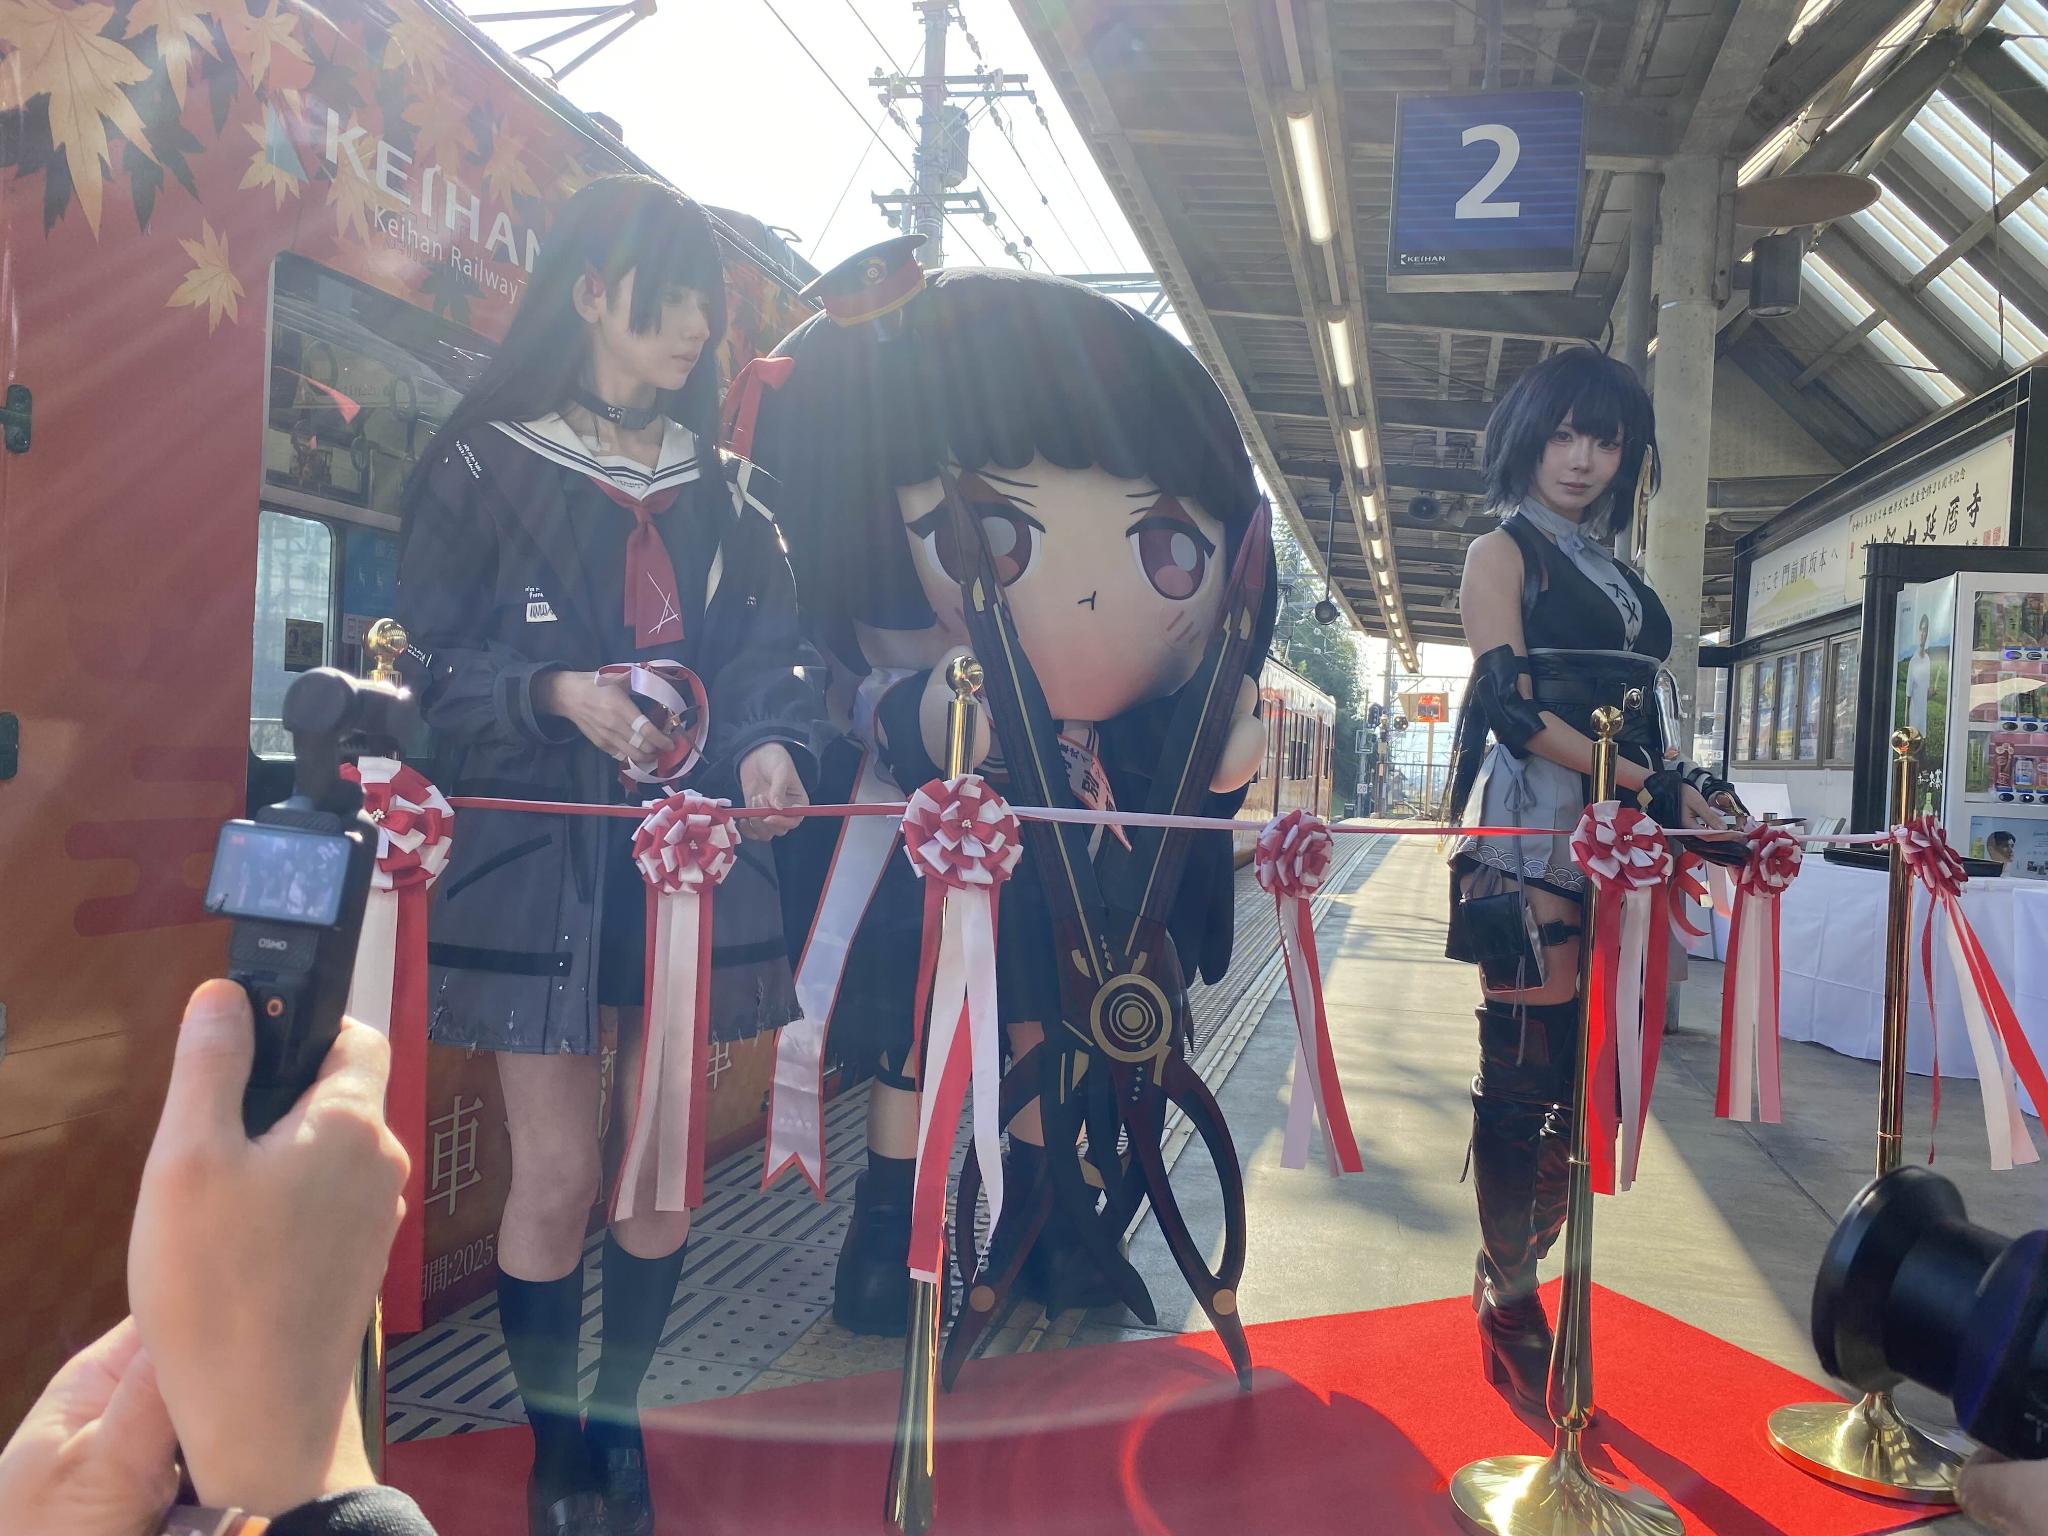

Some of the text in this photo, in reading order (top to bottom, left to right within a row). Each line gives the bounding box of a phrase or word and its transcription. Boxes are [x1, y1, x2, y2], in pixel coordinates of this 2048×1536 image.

[1455, 124, 1520, 219] 2
[374, 205, 518, 304] Keihan Railway
[258, 938, 287, 951] OSMO
